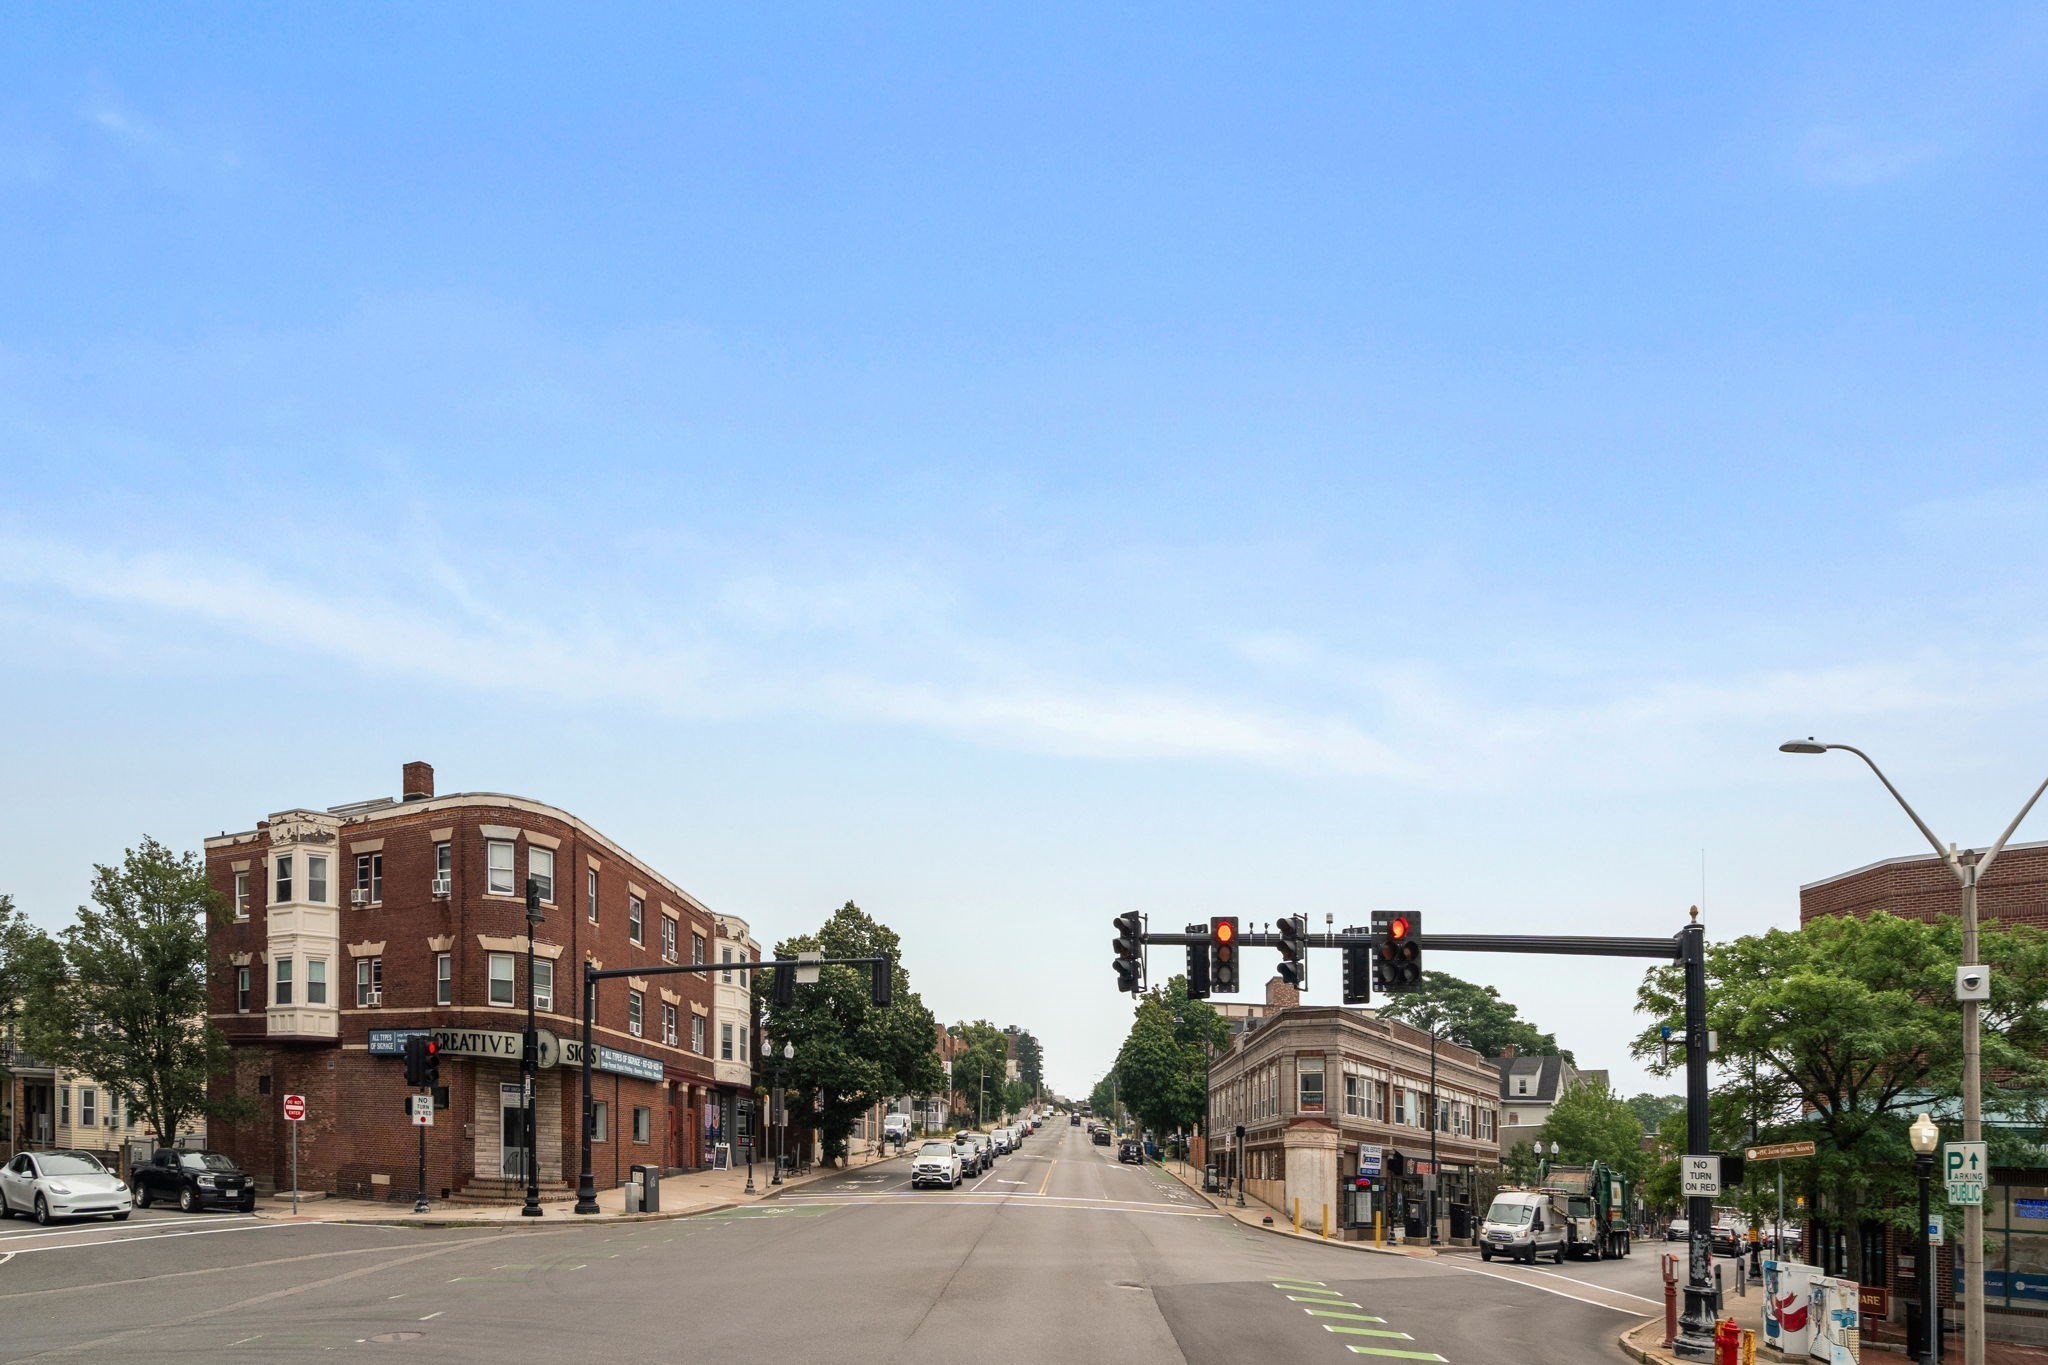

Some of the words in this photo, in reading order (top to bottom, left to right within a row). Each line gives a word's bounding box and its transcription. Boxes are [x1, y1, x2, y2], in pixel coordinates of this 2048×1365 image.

[380, 1034, 392, 1042] TYPES
[434, 1032, 516, 1054] CREATIVE
[612, 1052, 622, 1062] TYPES
[1693, 1161, 1708, 1169] NO
[1689, 1172, 1711, 1180] TURN
[1685, 1182, 1697, 1191] ON
[1700, 1183, 1717, 1192] RED
[1950, 1184, 1980, 1201] PUBLIC
[1859, 1295, 1881, 1306] ARE
